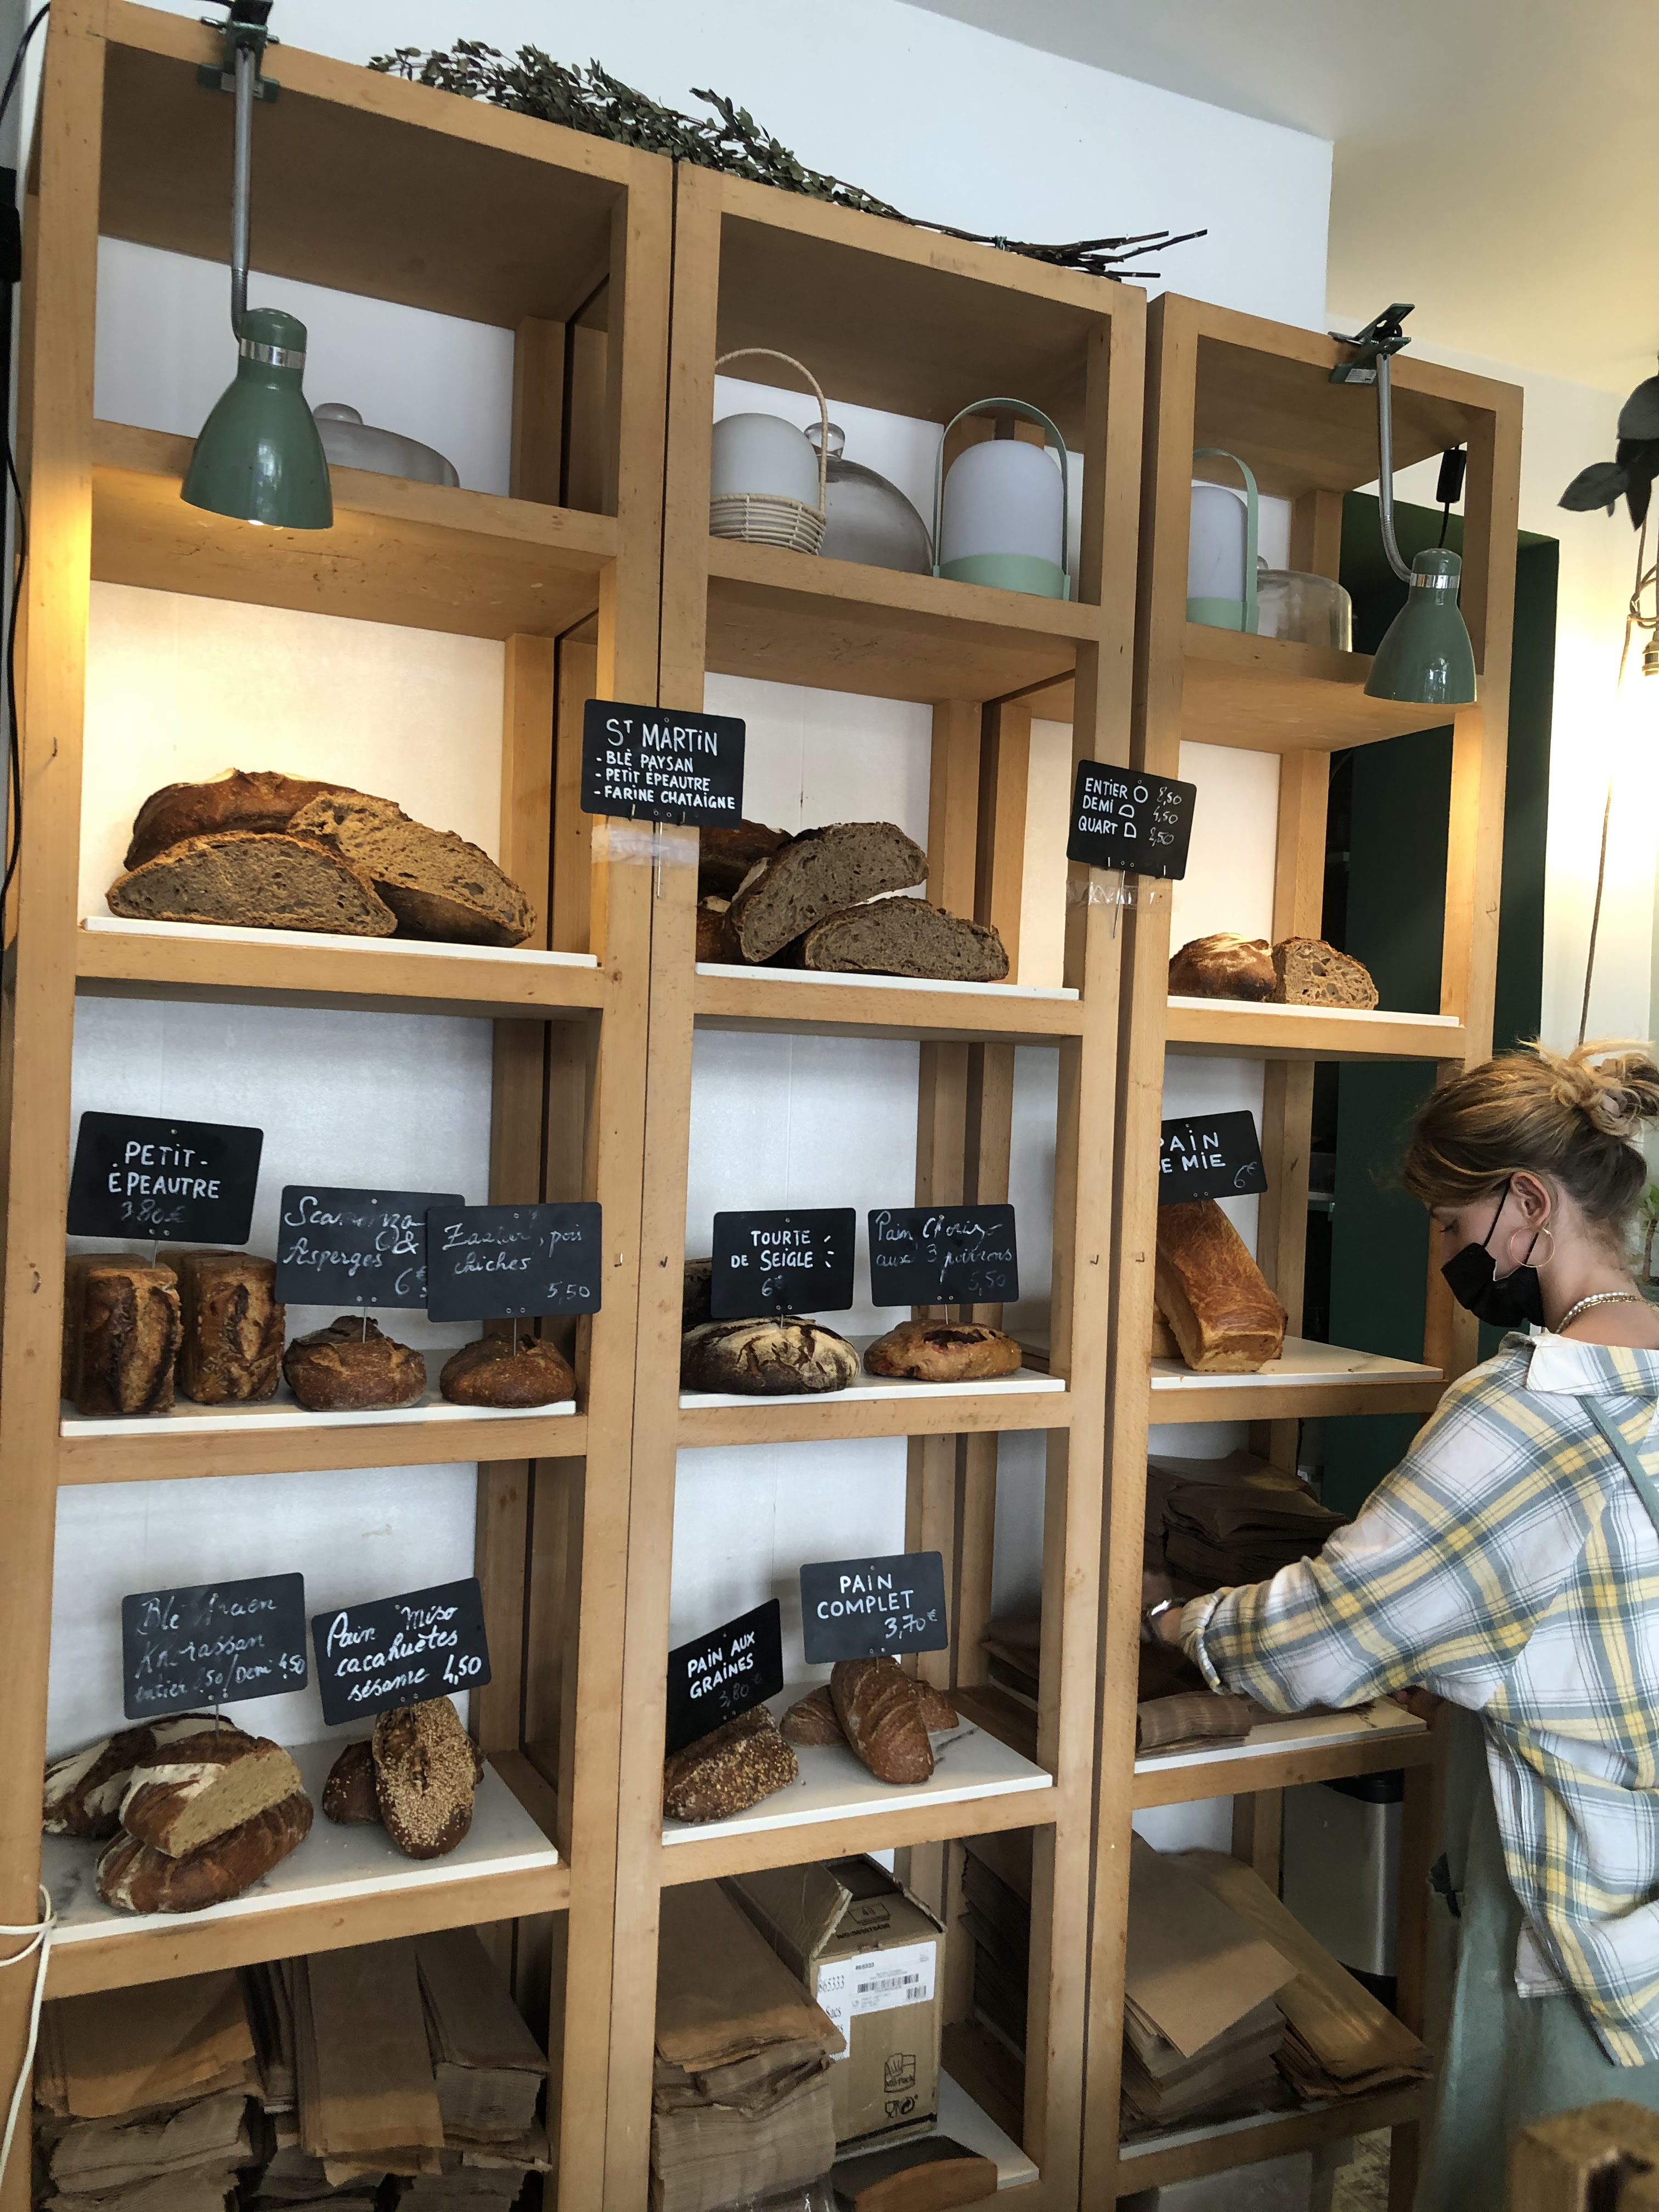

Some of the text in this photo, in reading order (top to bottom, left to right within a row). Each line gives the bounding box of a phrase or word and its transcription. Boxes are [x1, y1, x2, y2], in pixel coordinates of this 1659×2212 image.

[641, 754, 693, 773] PAYSAN
[1078, 815, 1118, 835] QUART
[751, 1230, 811, 1246] TOURTE
[455, 1251, 532, 1275] chiches
[731, 1255, 749, 1268] DE
[817, 1590, 914, 1619] COMPLET
[730, 1631, 755, 1657] AUX
